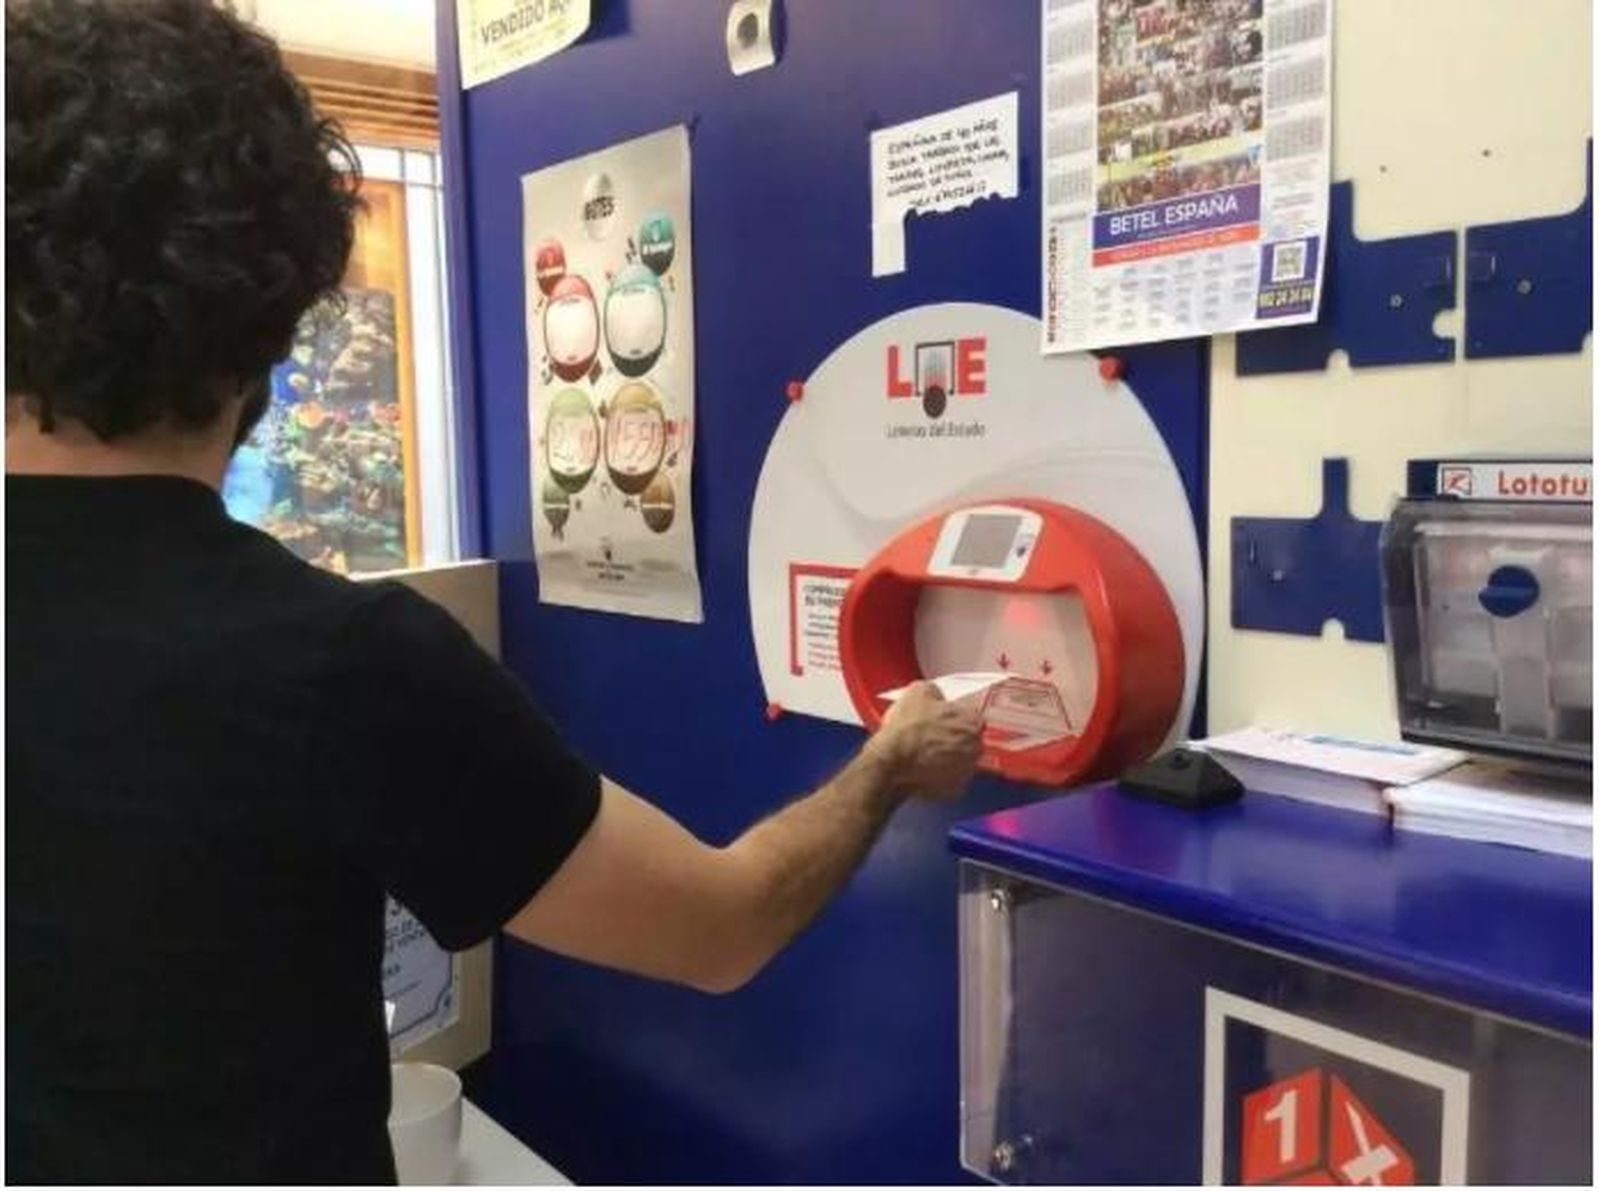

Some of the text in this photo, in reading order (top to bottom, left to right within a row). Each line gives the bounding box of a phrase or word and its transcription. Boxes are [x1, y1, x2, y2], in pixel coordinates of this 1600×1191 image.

[481, 0, 544, 44] VENDIDO
[1110, 210, 1160, 236] BETEL
[1165, 193, 1239, 225] ESPAÑA
[1264, 1090, 1298, 1164] 1
